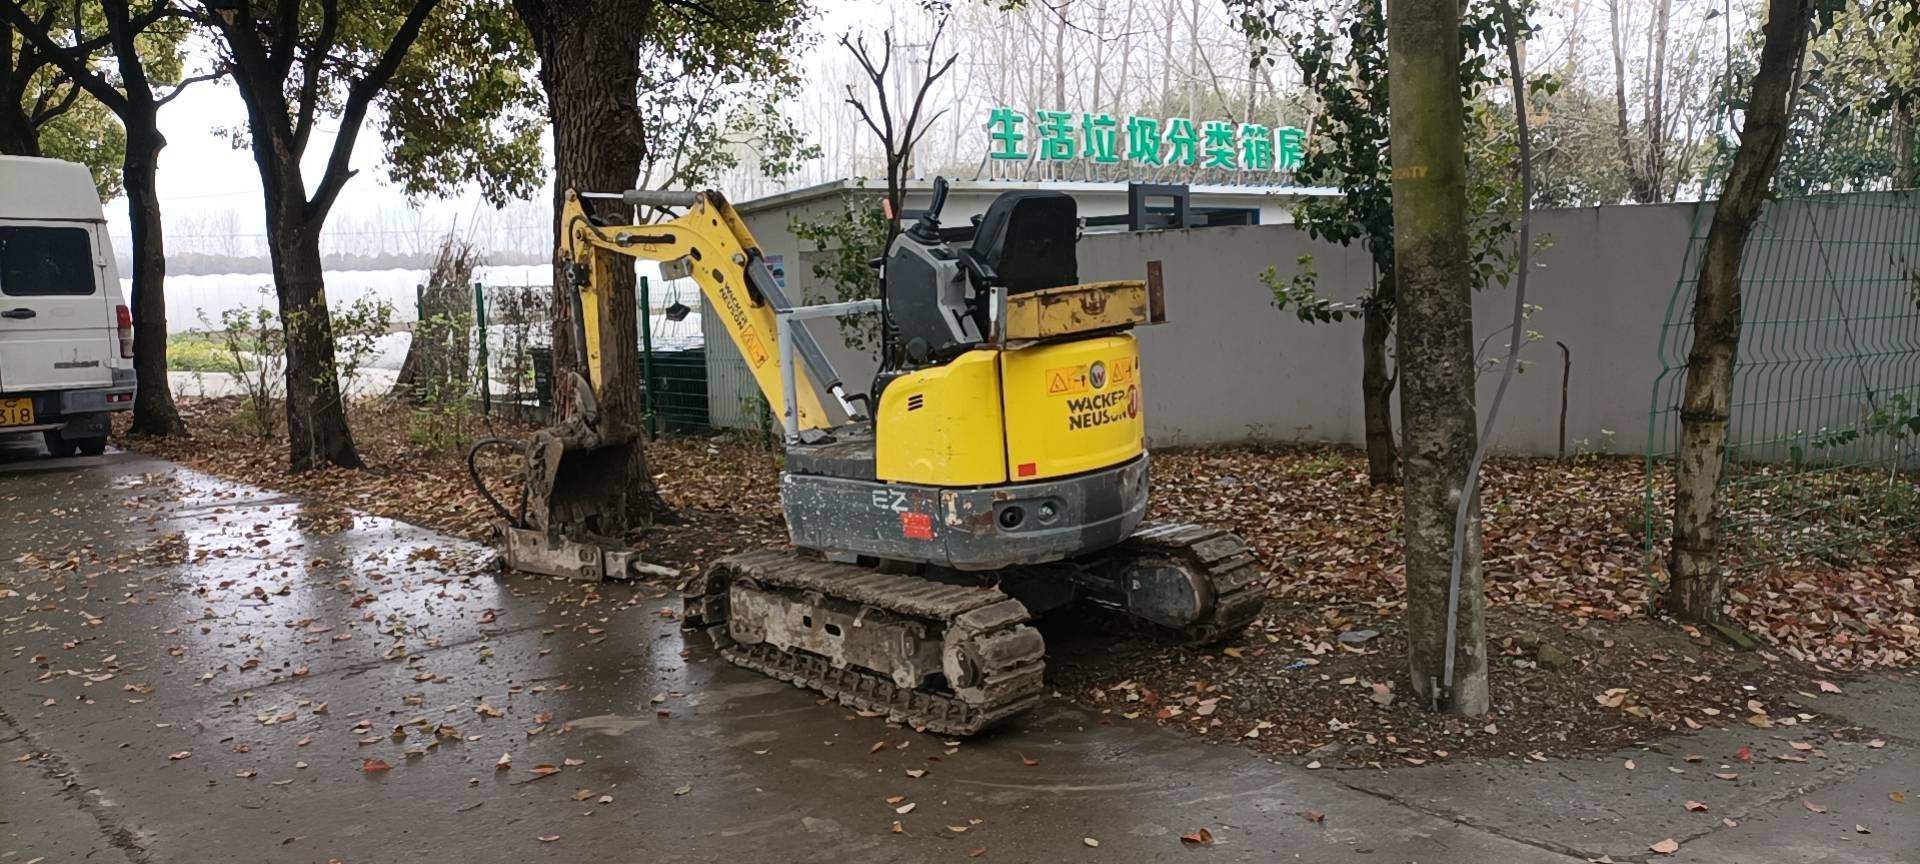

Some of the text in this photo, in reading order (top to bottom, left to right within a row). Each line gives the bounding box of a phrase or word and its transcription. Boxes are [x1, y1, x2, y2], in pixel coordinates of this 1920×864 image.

[987, 106, 1305, 172] 生活垃圾分类箱房
[719, 288, 745, 330] NEUSON
